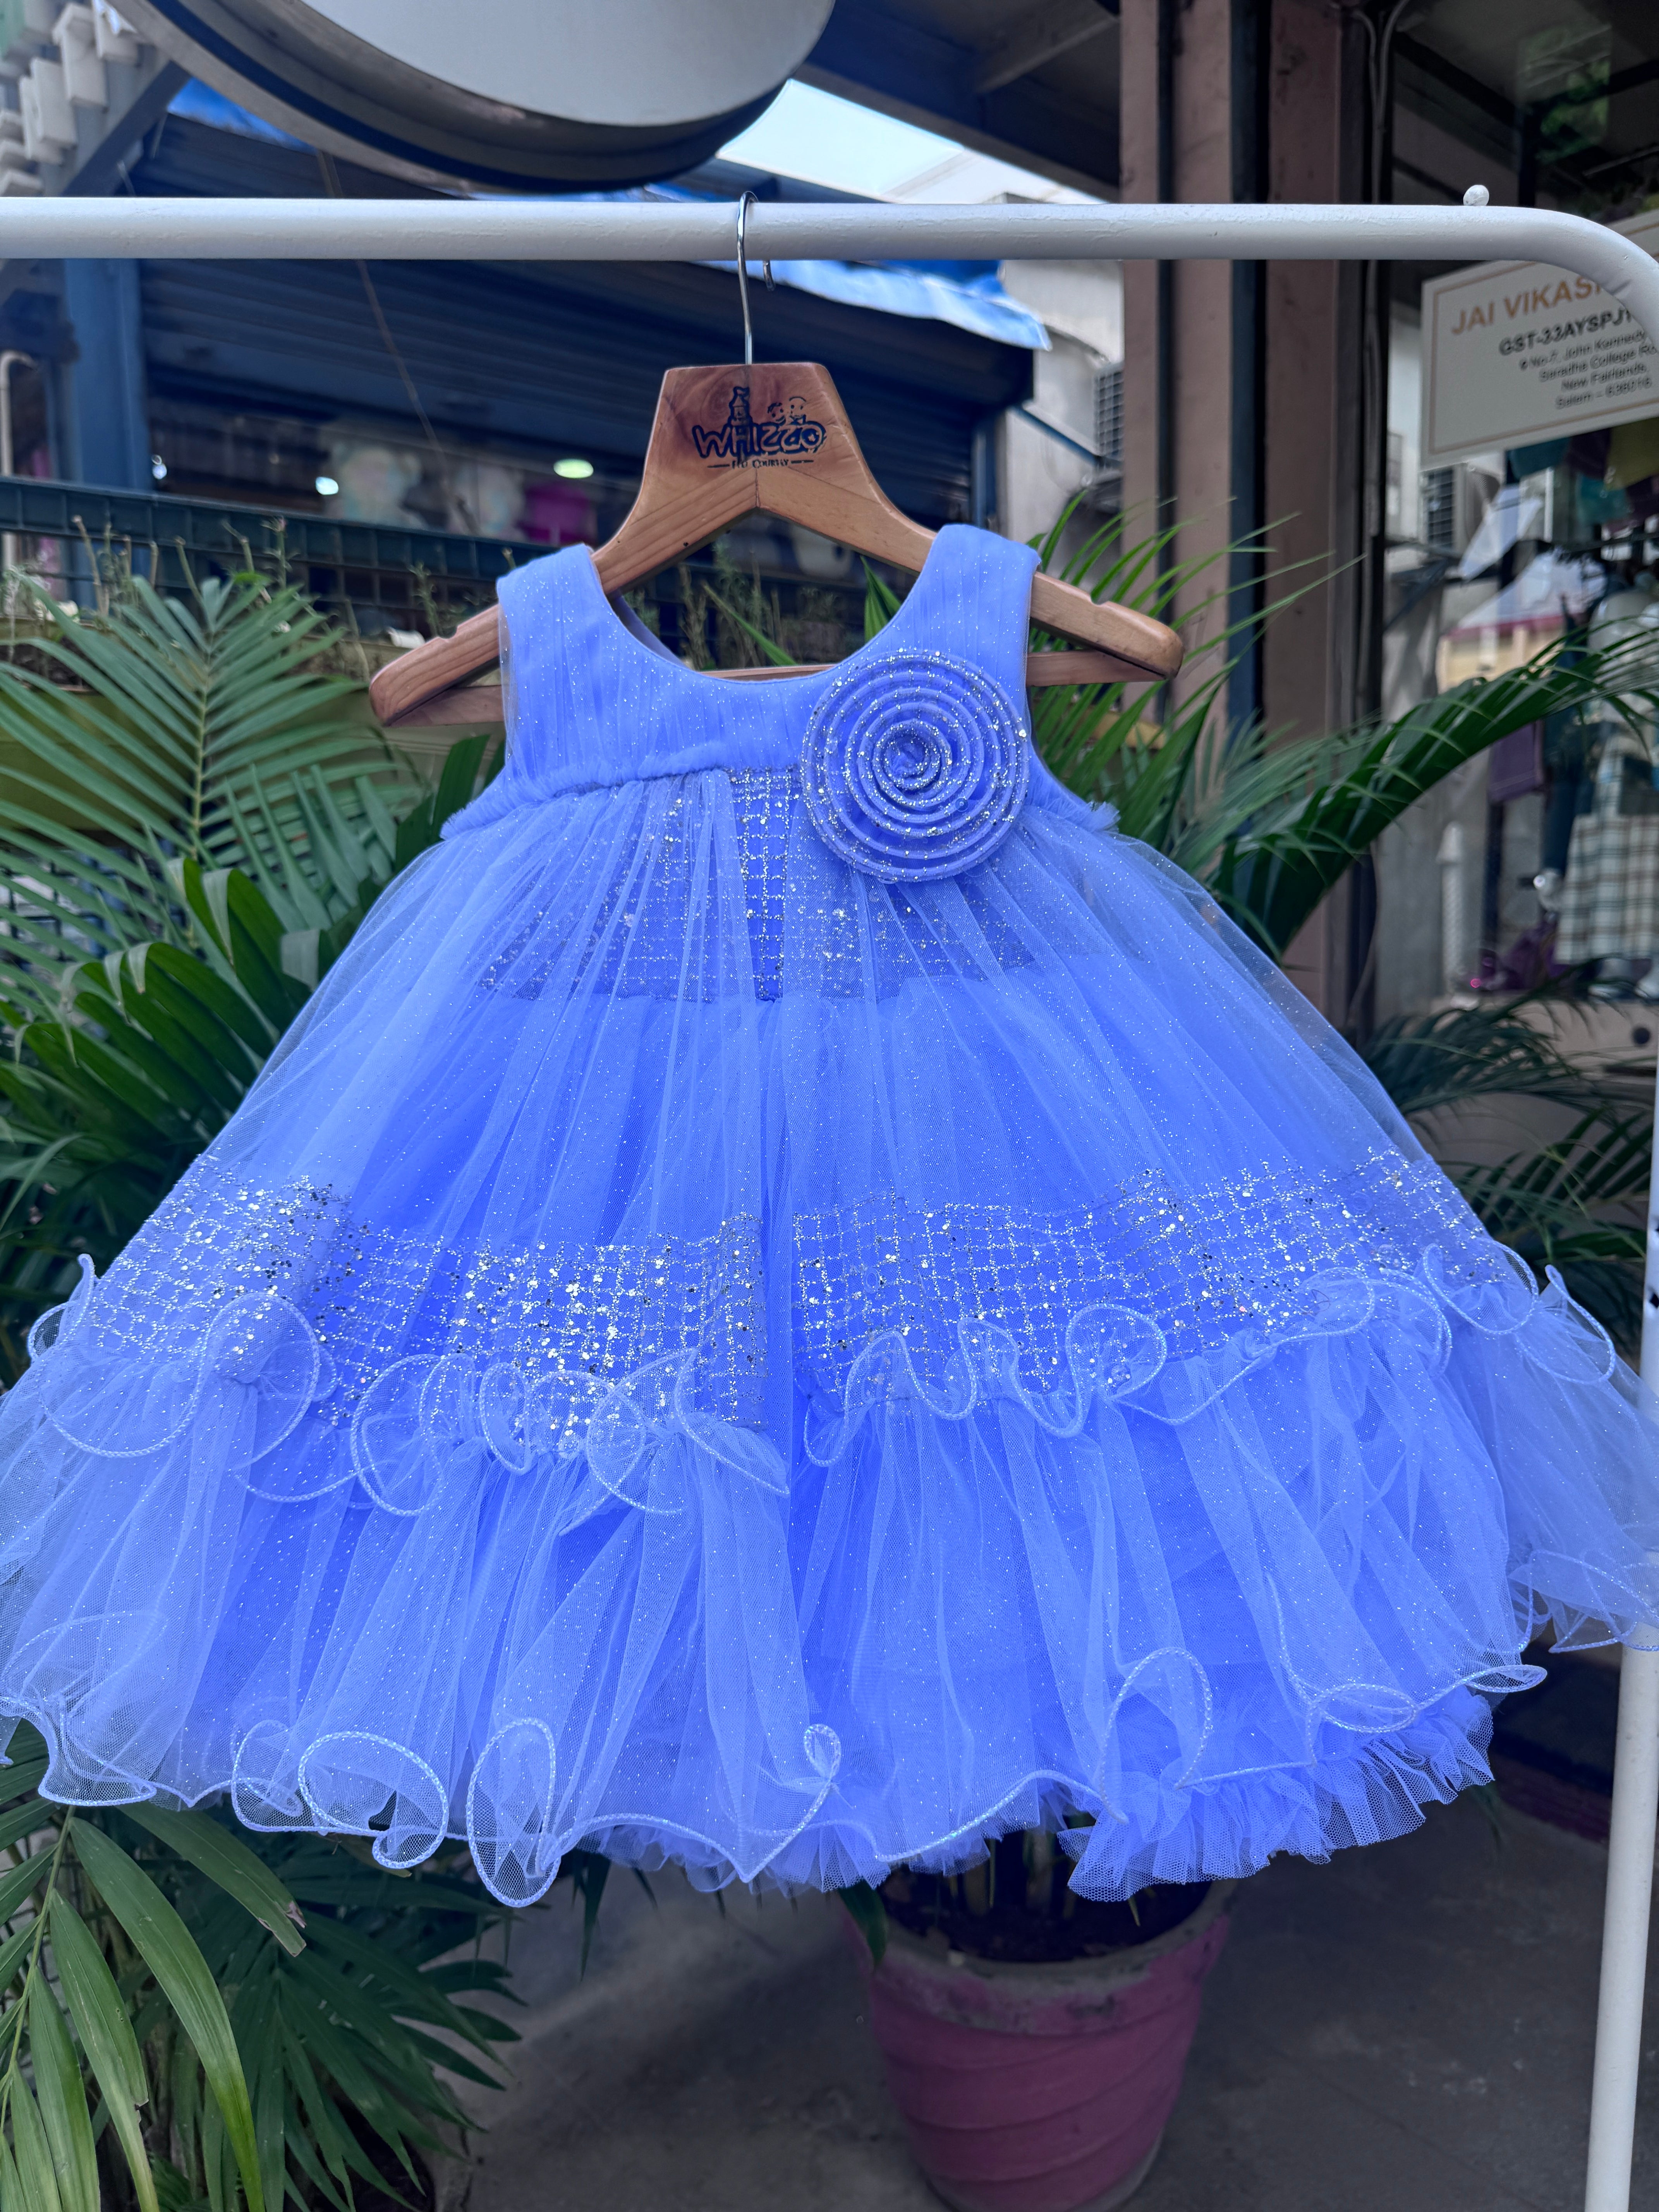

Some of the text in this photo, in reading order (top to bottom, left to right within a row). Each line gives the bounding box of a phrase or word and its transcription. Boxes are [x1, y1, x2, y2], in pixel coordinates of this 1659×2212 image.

[1452, 301, 1494, 335] JAI
[1590, 349, 1637, 369] College
[1561, 377, 1587, 392] New
[1555, 390, 1594, 409] Salem
